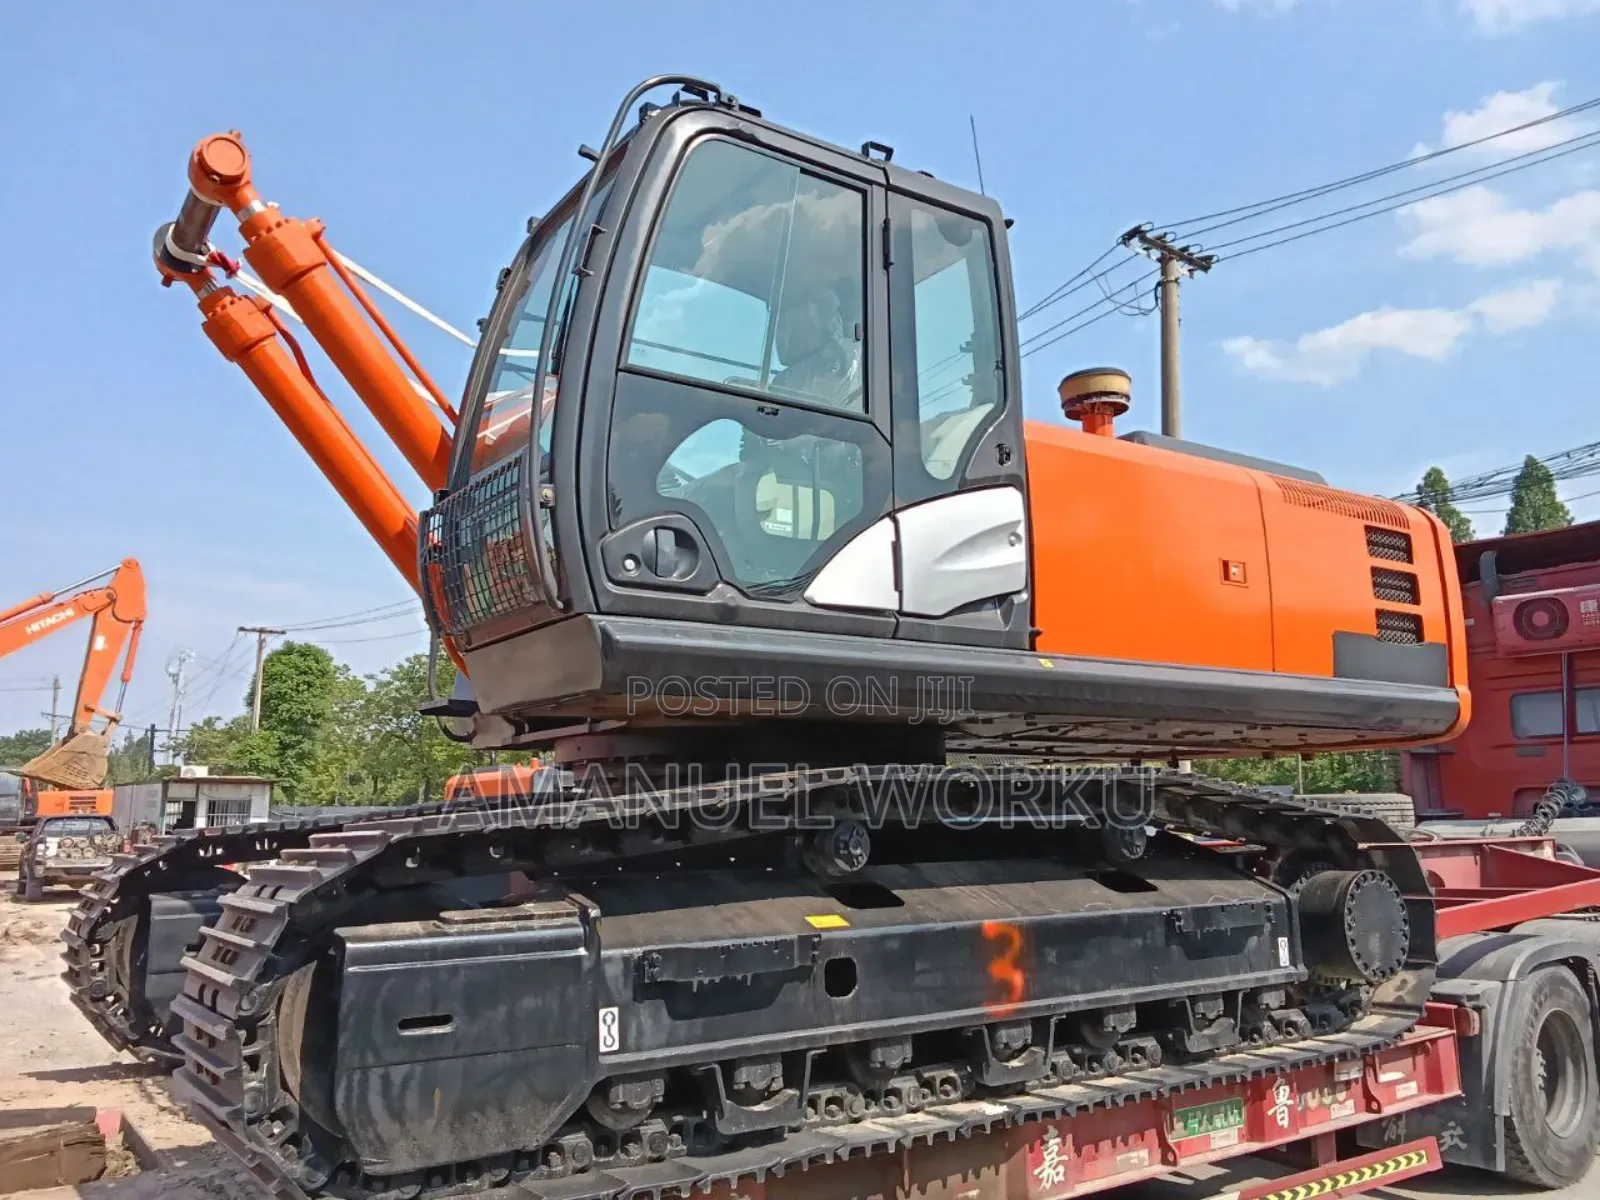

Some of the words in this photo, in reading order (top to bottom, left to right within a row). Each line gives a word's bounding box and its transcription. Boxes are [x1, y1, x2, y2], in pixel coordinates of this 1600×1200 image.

[24, 607, 75, 636] HITACHI
[981, 921, 1026, 1019] 3
[1033, 1125, 1070, 1191] 嘉
